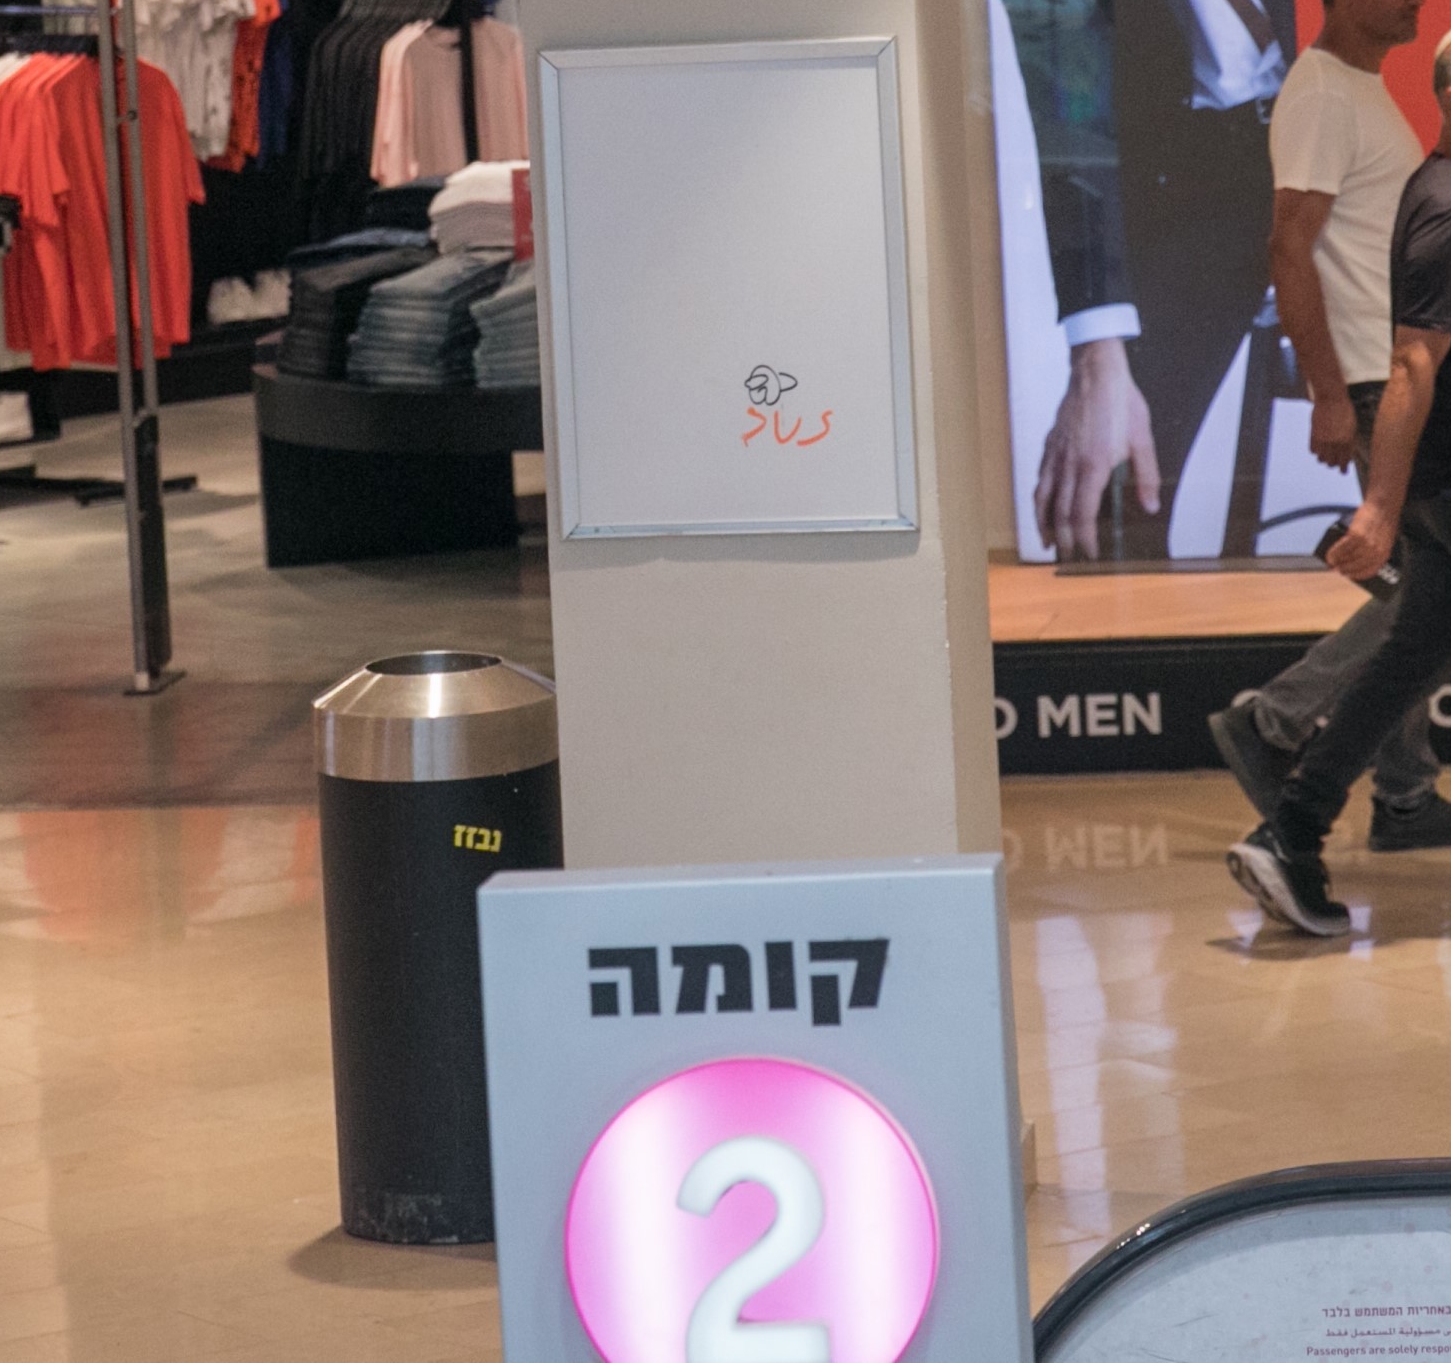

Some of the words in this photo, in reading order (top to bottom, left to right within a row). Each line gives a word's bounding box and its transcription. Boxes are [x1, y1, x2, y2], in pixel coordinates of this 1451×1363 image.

[1036, 692, 1163, 738] MEN
[587, 937, 891, 1027] קומה
[676, 1135, 831, 1363] 2
[1321, 1306, 1351, 1318] בלבד
[1354, 1306, 1404, 1317] המשתמש
[1306, 1345, 1367, 1358] Passengers
[1368, 1346, 1386, 1355] are
[1388, 1344, 1418, 1356] solely
